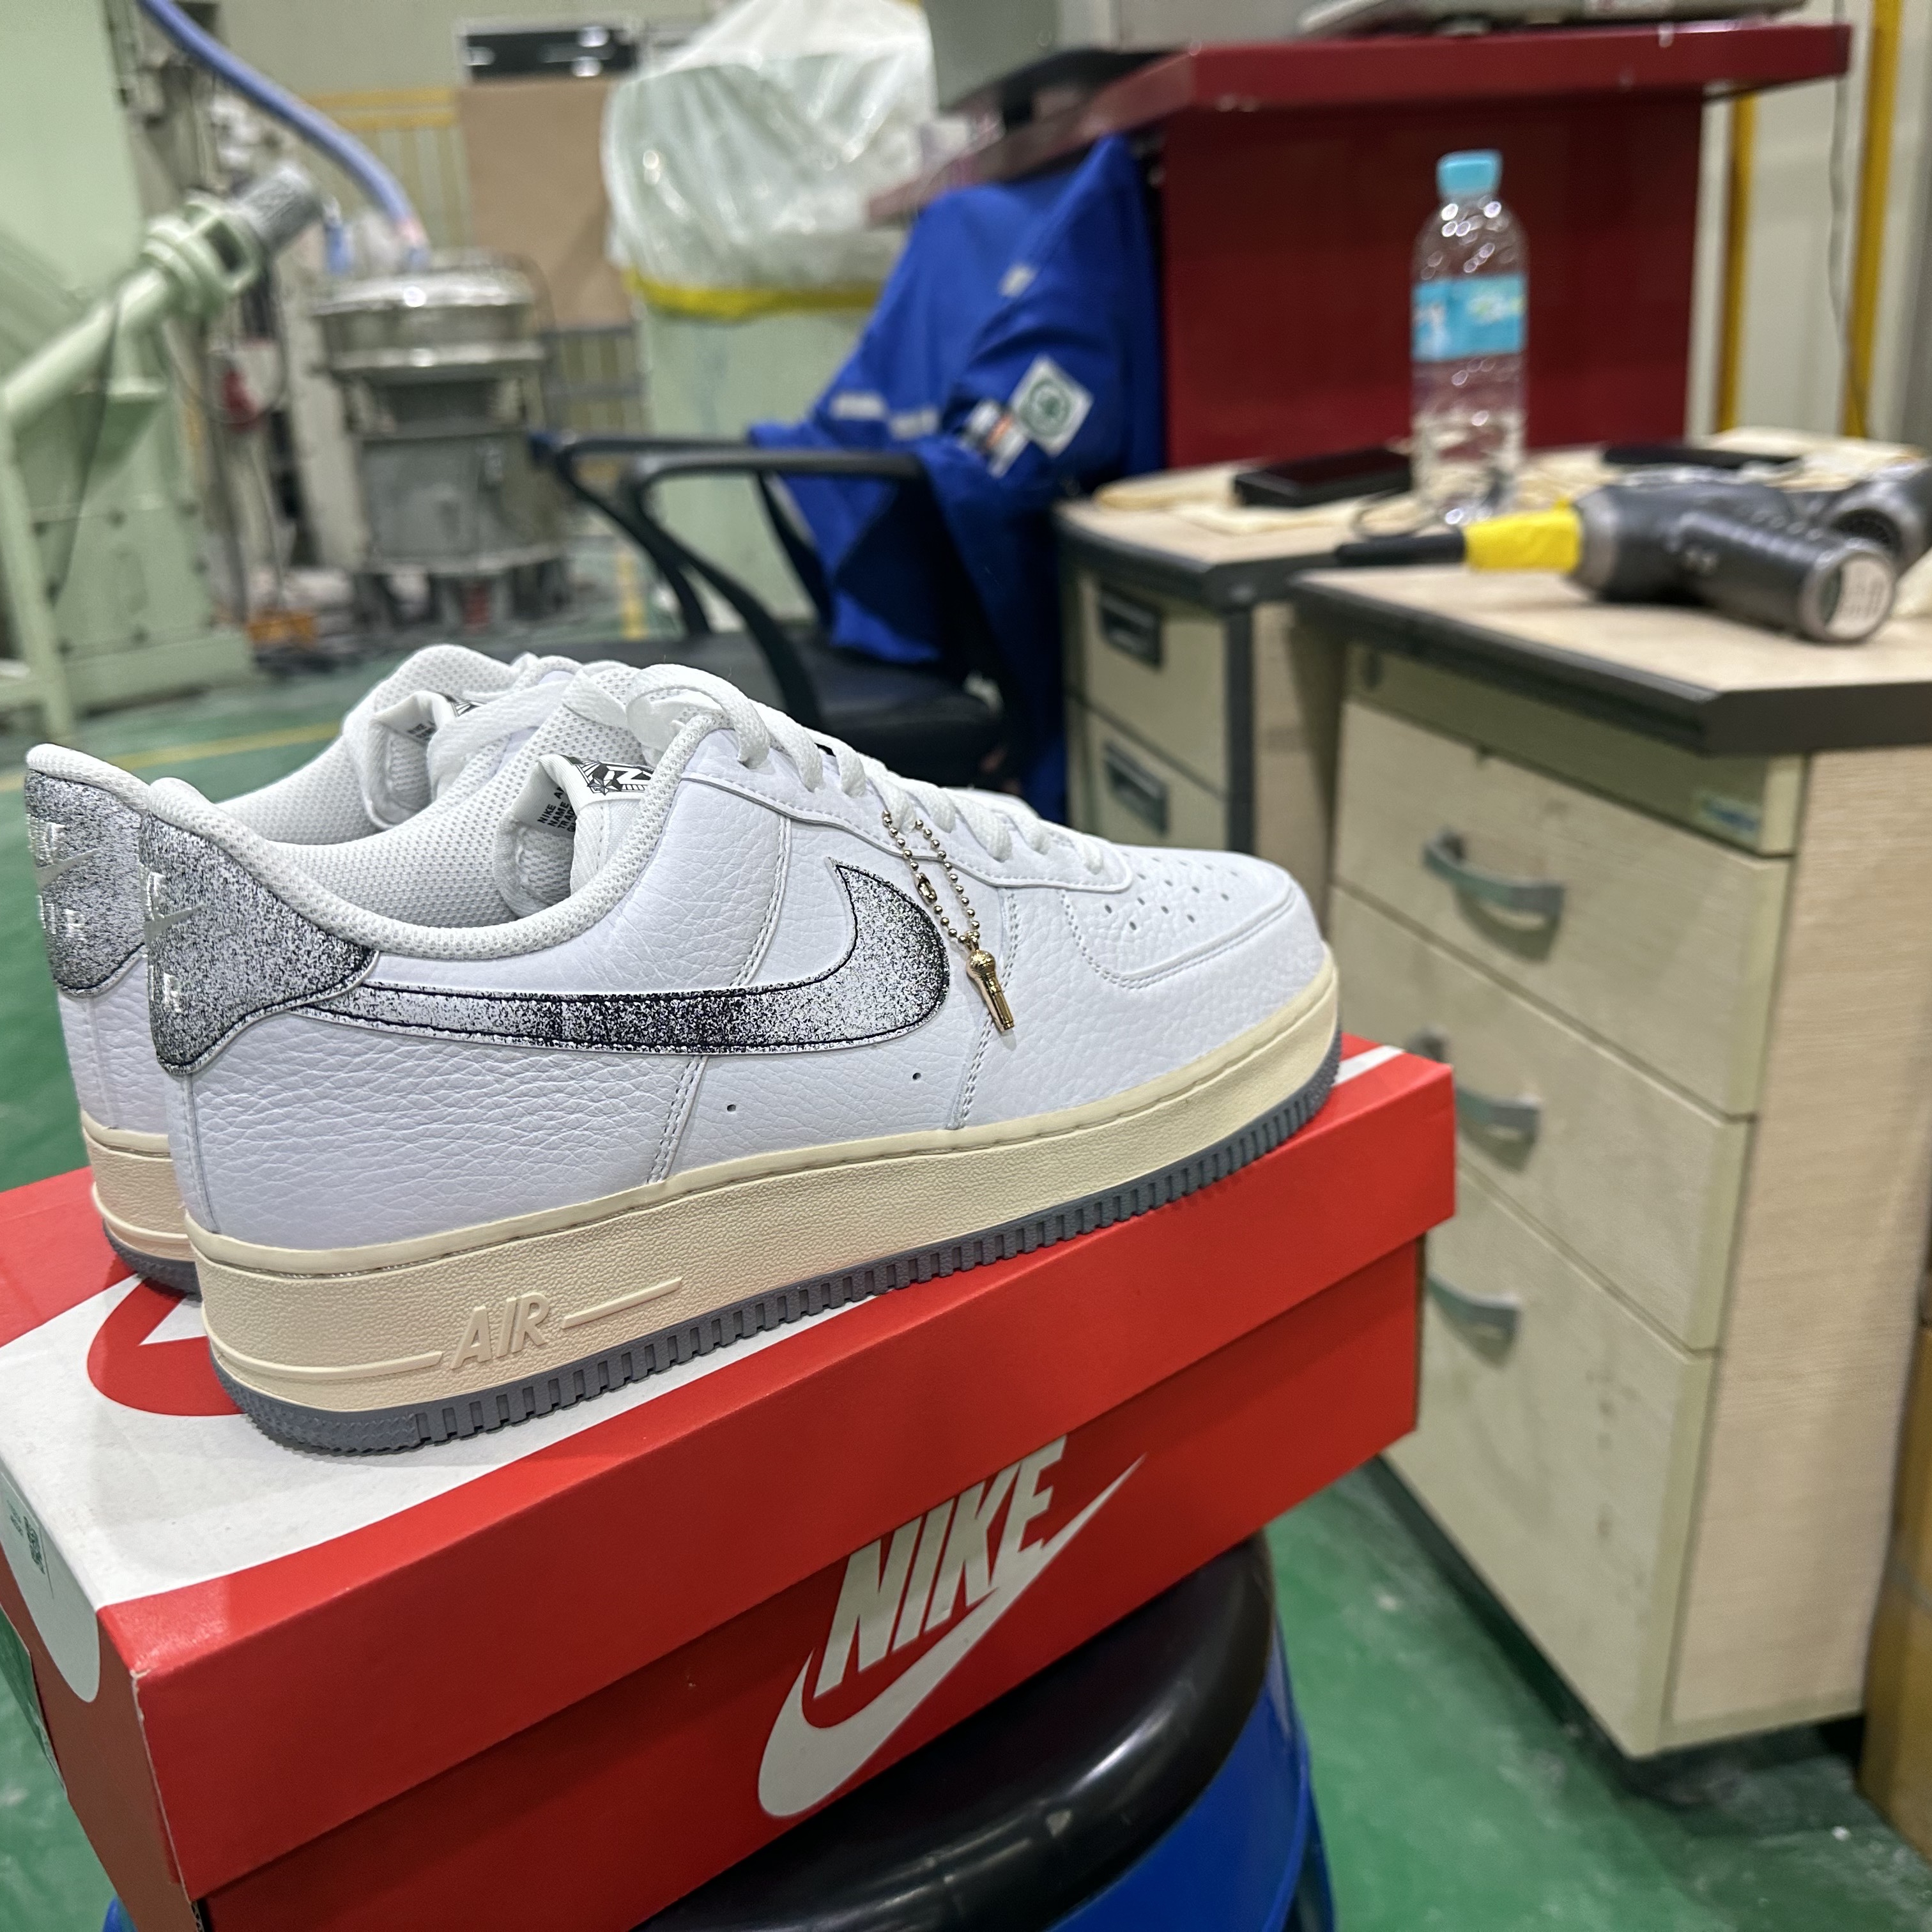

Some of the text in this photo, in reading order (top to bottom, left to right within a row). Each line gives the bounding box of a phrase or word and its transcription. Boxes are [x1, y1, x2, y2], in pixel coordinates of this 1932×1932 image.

[537, 804, 556, 824] NIKE
[547, 801, 570, 827] NAME
[450, 1292, 550, 1370] AIR
[813, 1434, 1068, 1699] NIKE
